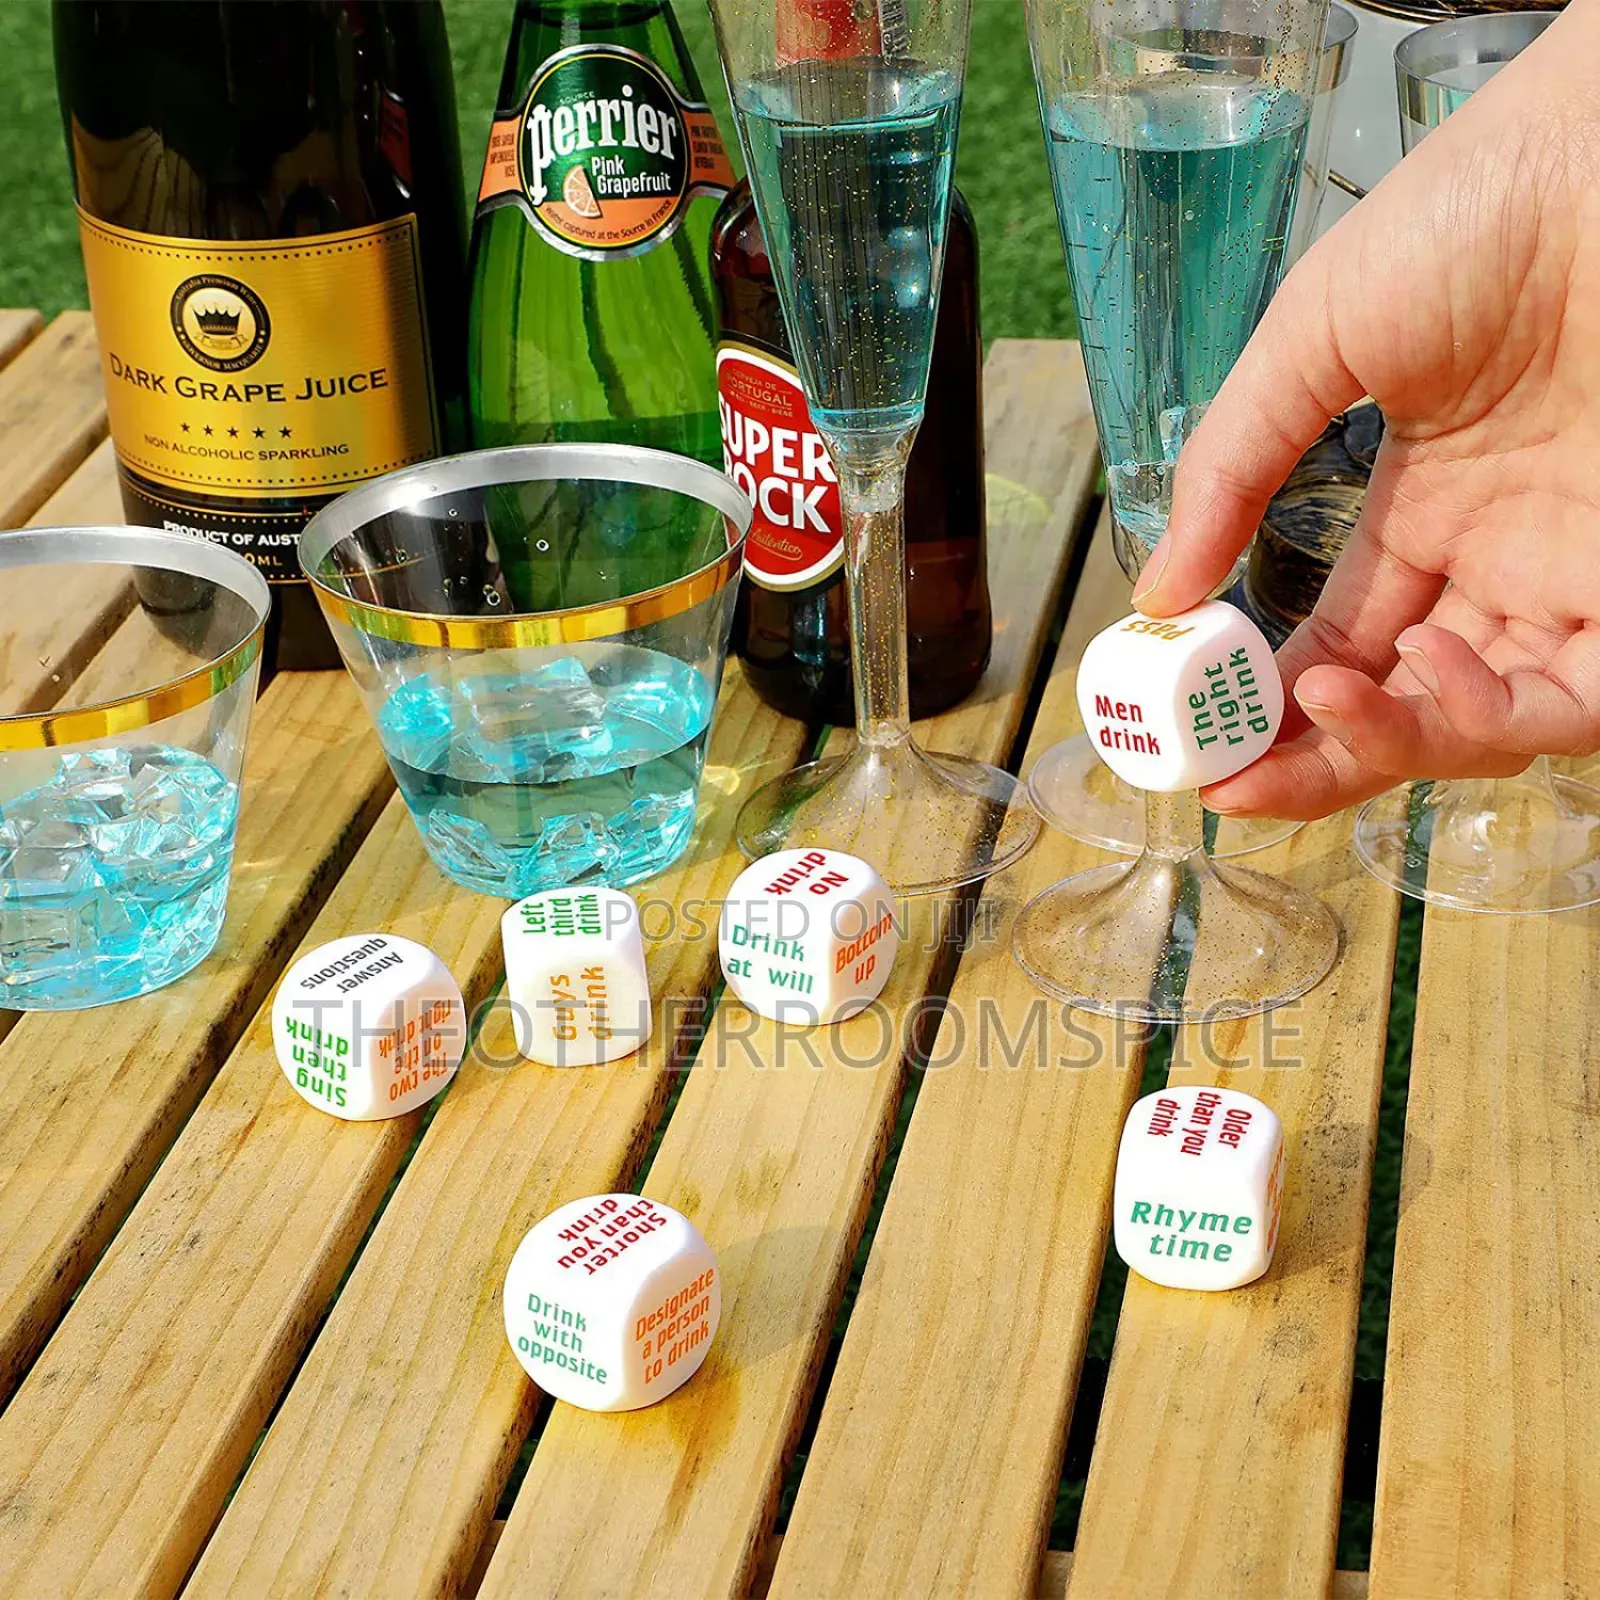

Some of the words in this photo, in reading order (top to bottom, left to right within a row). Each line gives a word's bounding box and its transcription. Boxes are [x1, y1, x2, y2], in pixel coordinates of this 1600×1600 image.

[591, 154, 625, 176] Pink
[597, 172, 672, 198] Grapefruit
[563, 222, 595, 239] captured
[598, 231, 606, 239] at
[607, 230, 620, 239] the
[621, 223, 646, 238] Source
[652, 199, 672, 222] France
[144, 434, 169, 451] NON
[171, 444, 254, 461] ALCOHOLIC
[258, 443, 349, 461] SPARKLING
[719, 391, 838, 482] SUPER
[231, 533, 254, 546] OF
[1120, 620, 1196, 640] Pass
[1095, 694, 1143, 723] Men
[1204, 662, 1244, 746] right
[1229, 647, 1269, 734] drink
[1188, 691, 1218, 750] The
[1100, 726, 1161, 755] drink
[764, 851, 827, 896] drink
[809, 871, 849, 895] No
[520, 902, 546, 934] Left
[549, 898, 575, 936] third
[575, 894, 602, 935] drink
[732, 924, 805, 962] Drink
[836, 912, 893, 974] Bottom
[300, 938, 388, 990] questions
[336, 951, 404, 994] Answer
[727, 957, 752, 978] at
[768, 967, 813, 994] will
[855, 954, 876, 985] up
[418, 998, 451, 1033] right
[550, 974, 577, 1041] Guys
[580, 965, 613, 1041] drink
[285, 1016, 349, 1057] drink
[379, 1021, 415, 1058] drink
[424, 1032, 442, 1056] on
[292, 1045, 347, 1082] then
[394, 1045, 419, 1074] the
[296, 1067, 348, 1108] Sing
[390, 1070, 418, 1101] two
[1147, 1098, 1181, 1137] drink
[1190, 1091, 1222, 1126] than
[1181, 1127, 1209, 1156] you
[1218, 1108, 1253, 1149] Older
[558, 1198, 619, 1242] drink
[600, 1199, 654, 1238] than
[1130, 1201, 1253, 1235] Rhyme
[557, 1236, 603, 1269] you
[583, 1212, 667, 1275] Shorter
[1150, 1234, 1233, 1262] time
[527, 1293, 587, 1332] Drink
[635, 1268, 714, 1342] Designate
[533, 1319, 582, 1353] with
[642, 1339, 653, 1360] a
[657, 1295, 709, 1353] person
[517, 1335, 608, 1385] opposite
[644, 1359, 662, 1385] to
[668, 1321, 709, 1367] drink
